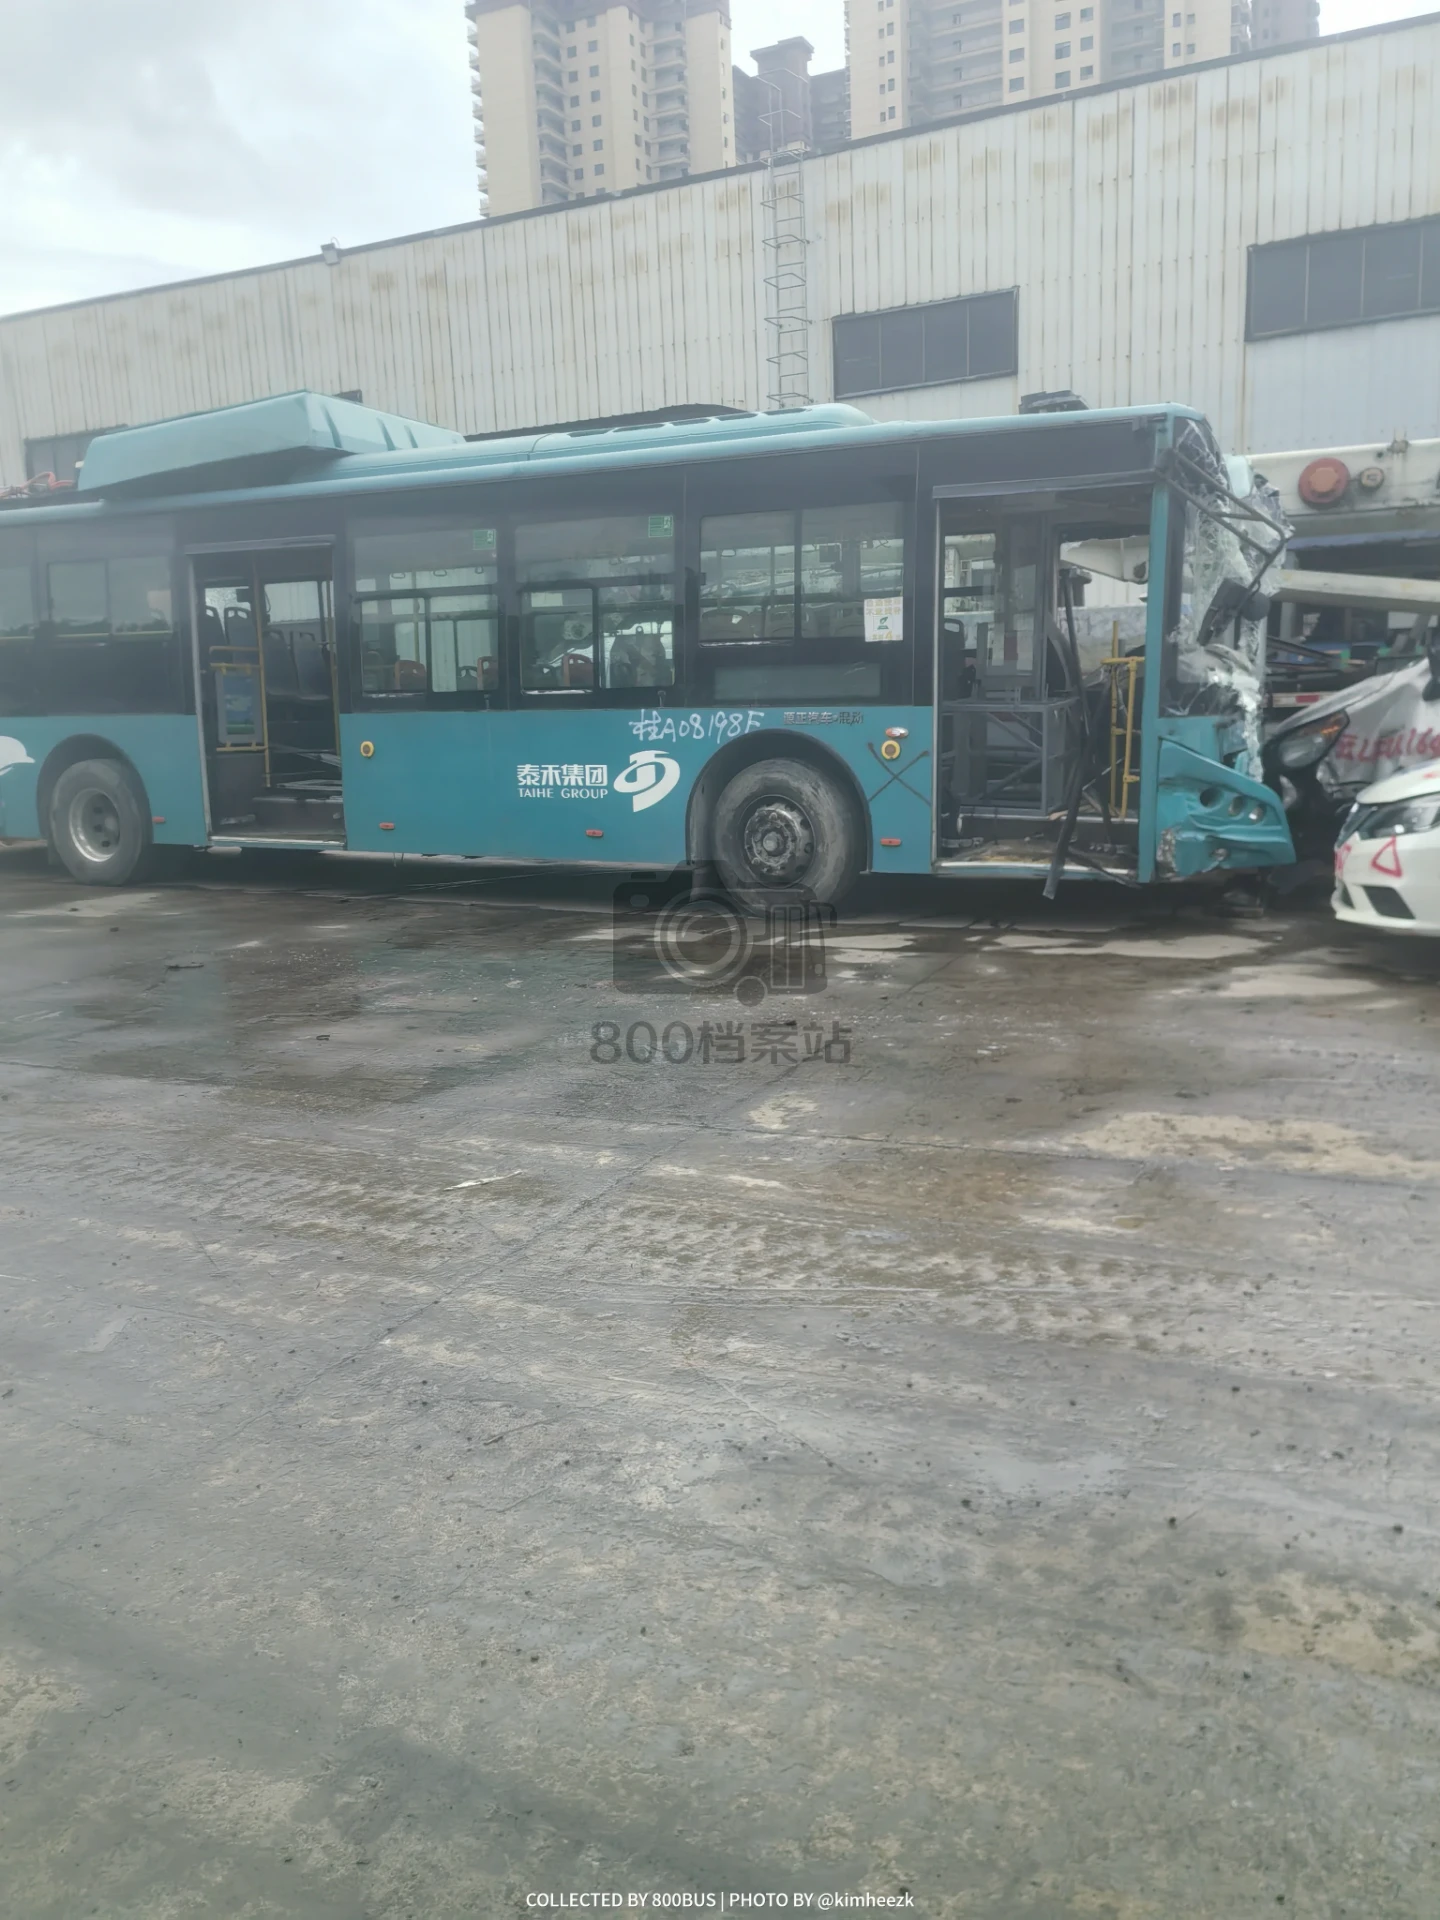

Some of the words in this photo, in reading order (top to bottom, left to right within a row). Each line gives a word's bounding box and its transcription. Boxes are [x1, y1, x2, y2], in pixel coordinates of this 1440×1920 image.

[517, 764, 608, 787] 泰禾集团
[518, 788, 554, 798] TAIHE
[561, 788, 608, 799] GROUP
